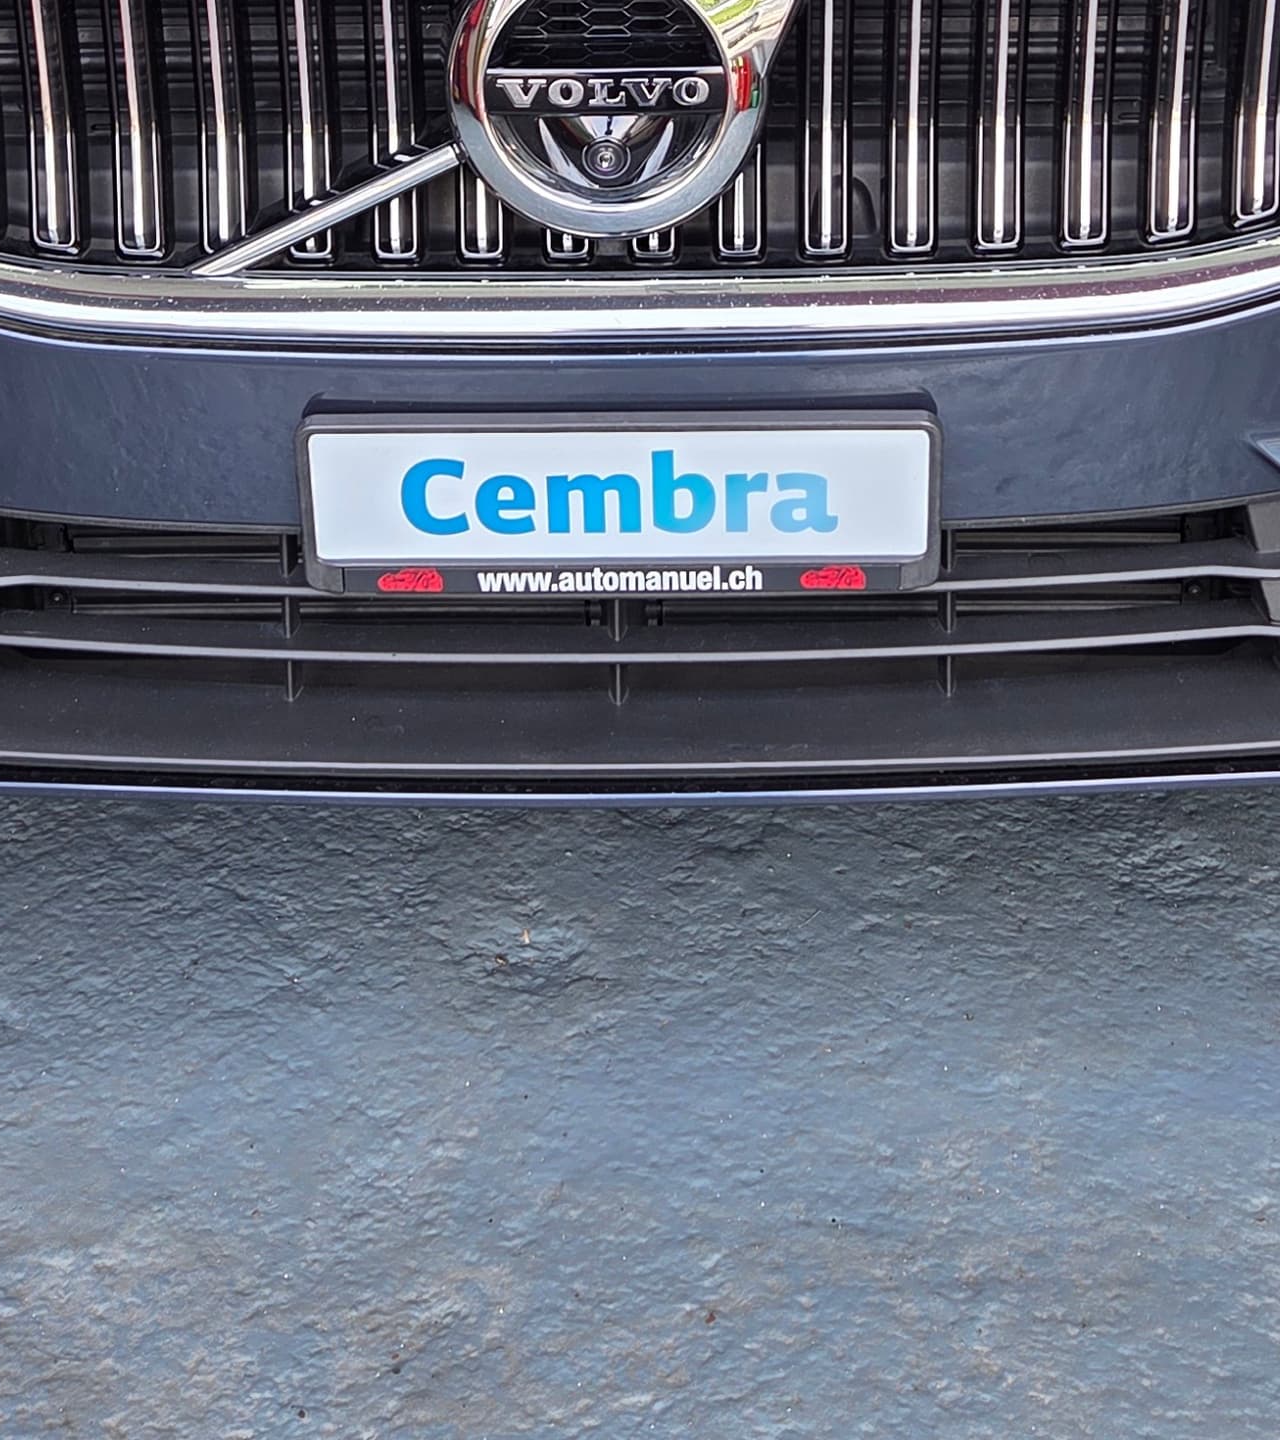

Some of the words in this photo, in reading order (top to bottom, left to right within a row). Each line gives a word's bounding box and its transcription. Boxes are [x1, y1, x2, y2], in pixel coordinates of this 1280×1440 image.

[496, 77, 710, 108] VOLVO
[400, 449, 839, 536] Cembra
[477, 565, 763, 592] www.automanuel.ch
